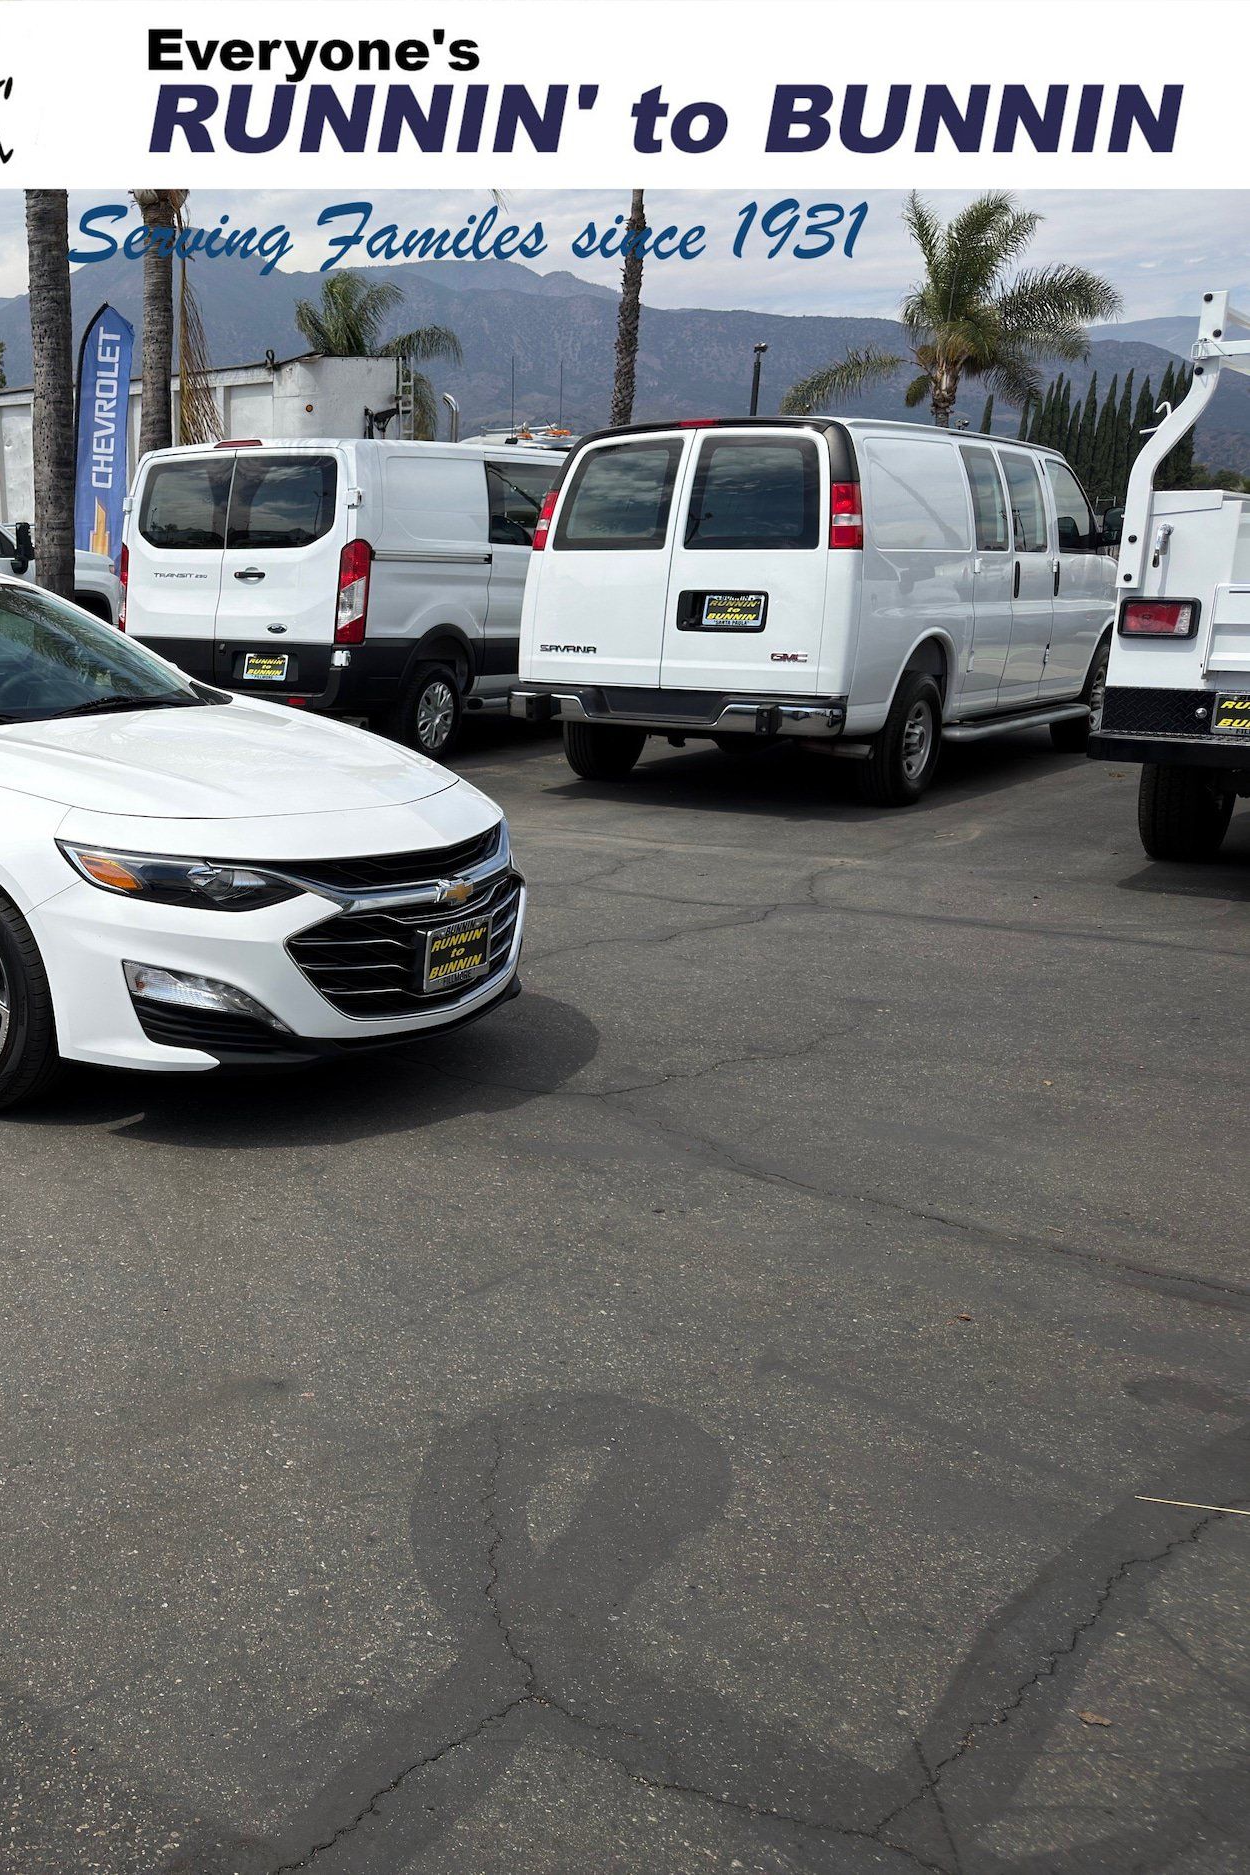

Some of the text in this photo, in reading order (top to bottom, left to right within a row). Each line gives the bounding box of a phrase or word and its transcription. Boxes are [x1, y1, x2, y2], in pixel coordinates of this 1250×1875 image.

[91, 326, 121, 490] CHEVROLET
[708, 600, 761, 608] RUNNIN'
[706, 612, 757, 621] BUNNIN
[540, 644, 597, 654] SAVANA
[770, 652, 808, 663] GMC
[247, 668, 283, 676] BUNNIN
[1220, 700, 1250, 710] RU
[1217, 718, 1250, 728] BU
[430, 926, 487, 953] RUNNIN'
[450, 947, 466, 958] to
[429, 952, 483, 980] BUNNIN
